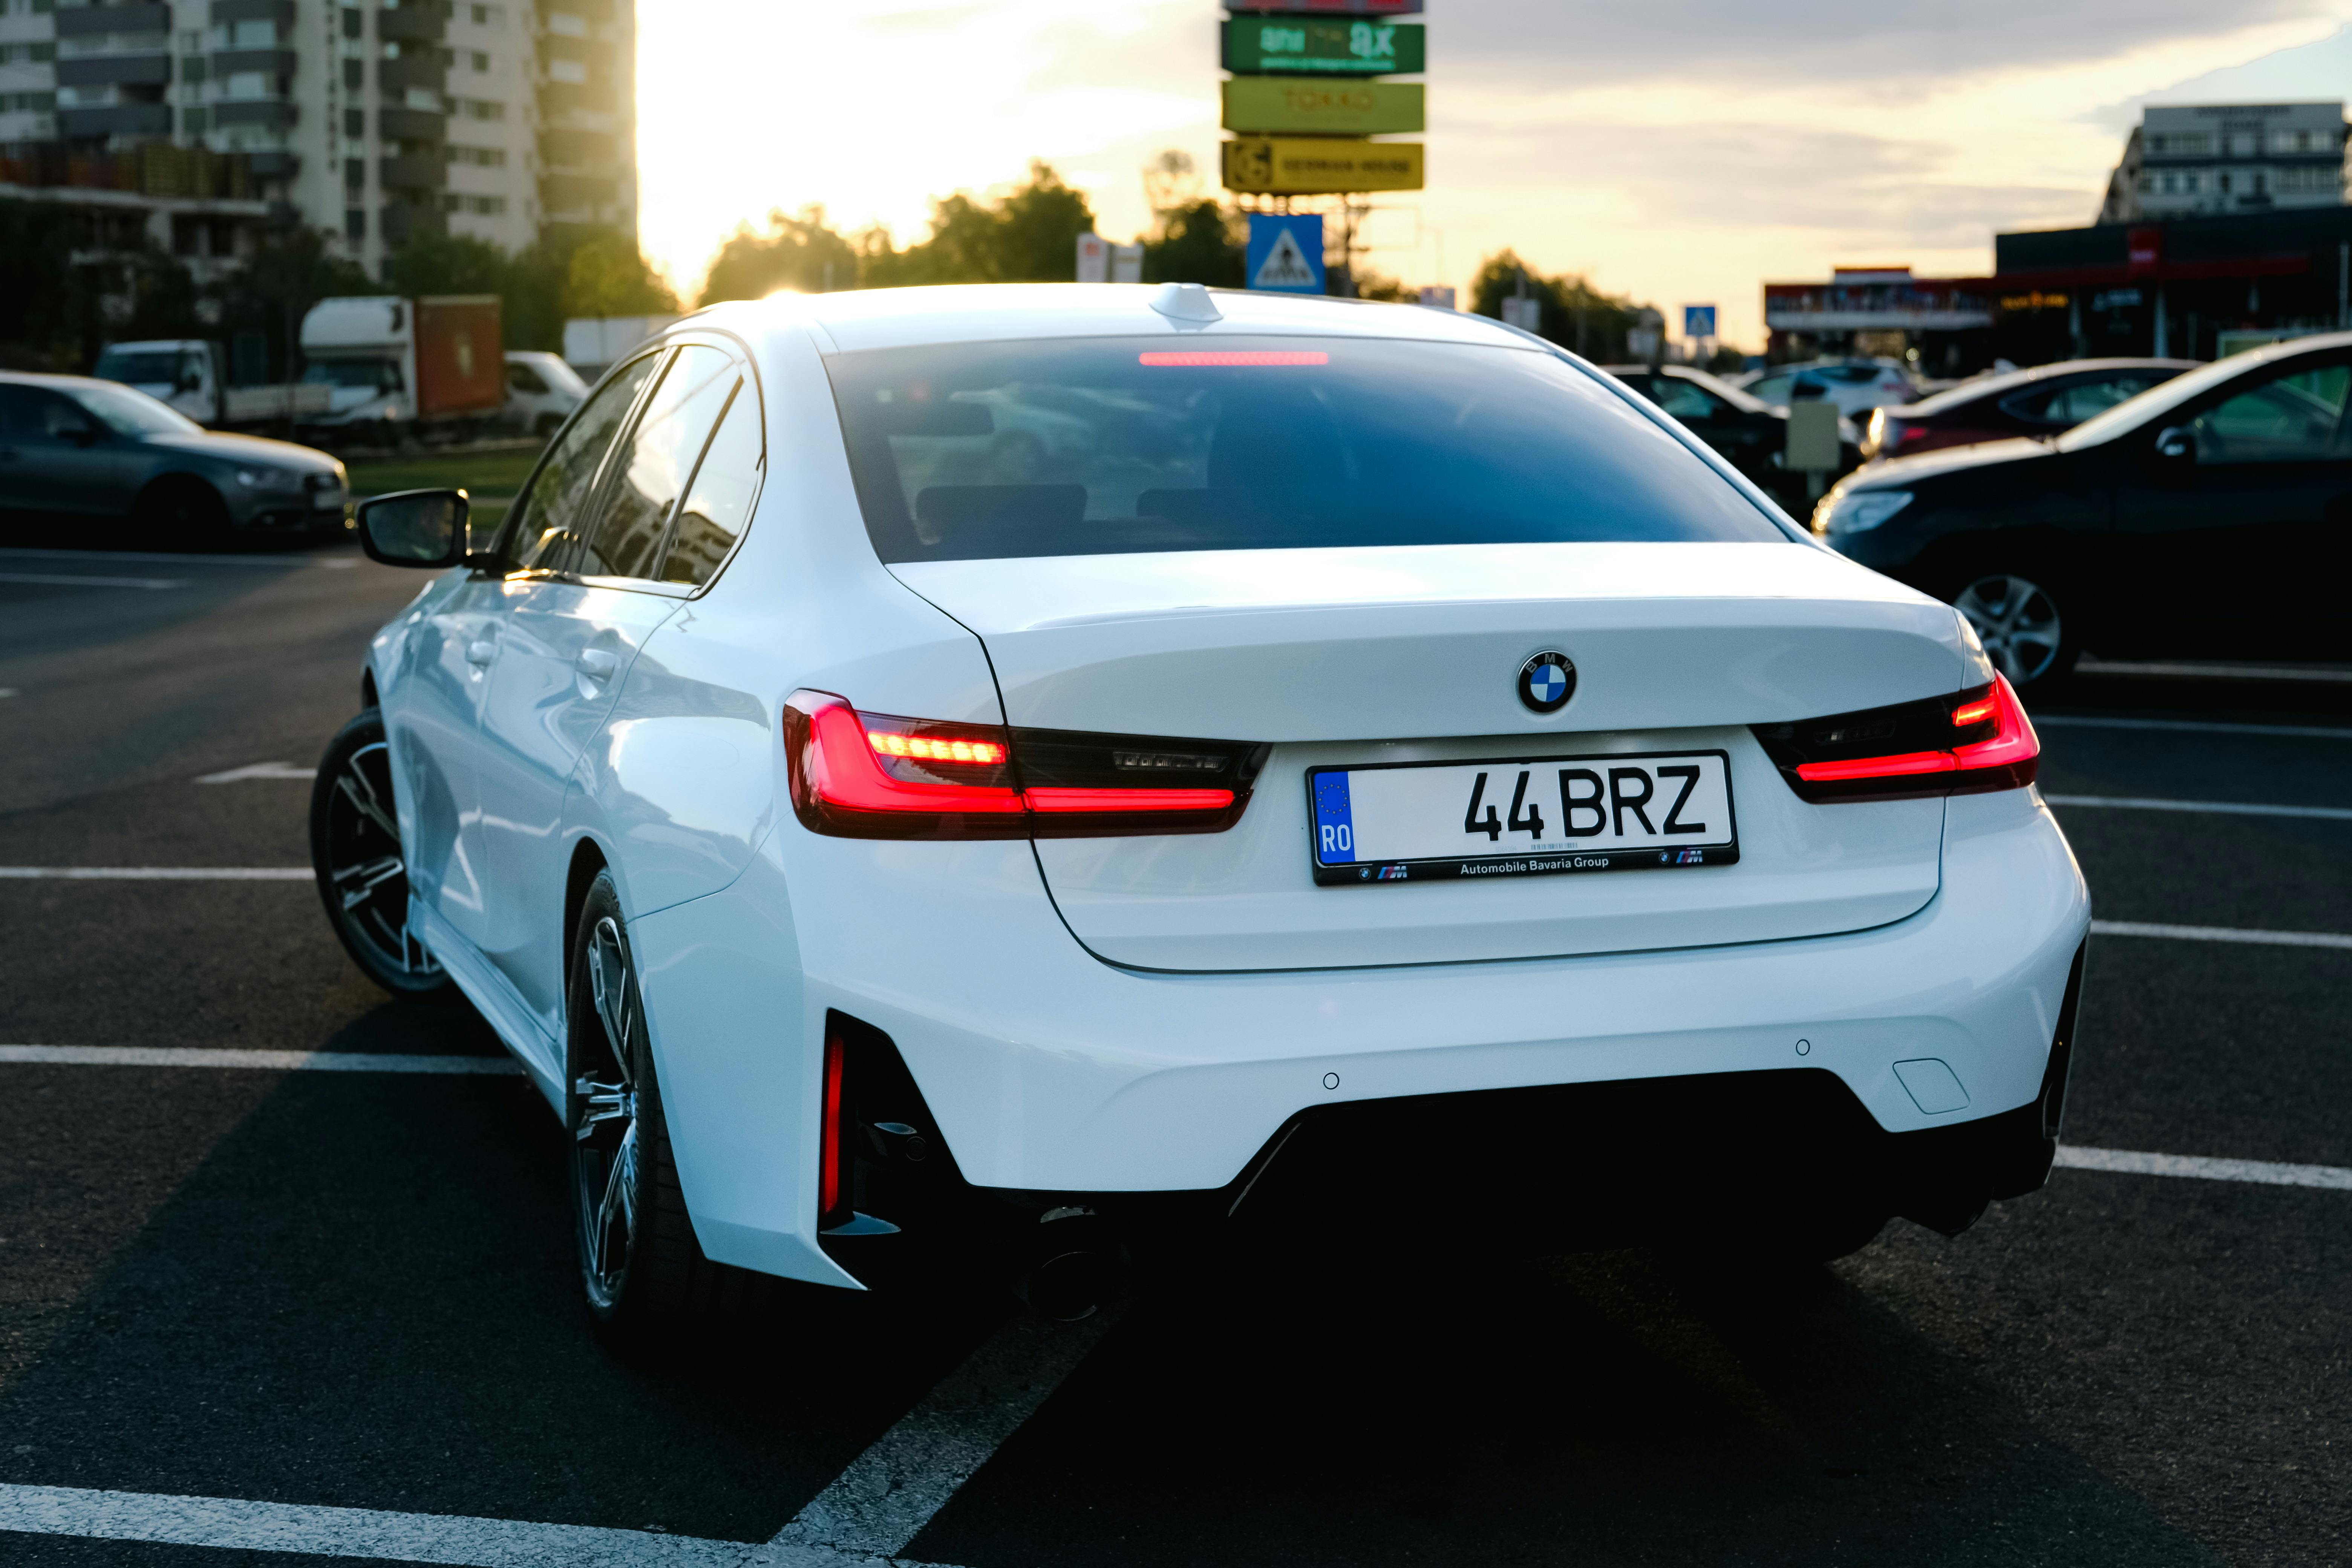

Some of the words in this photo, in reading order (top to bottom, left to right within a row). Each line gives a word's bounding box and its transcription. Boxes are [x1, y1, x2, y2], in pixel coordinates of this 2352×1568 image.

[1525, 653, 1573, 673] BMW
[1464, 770, 1545, 841] 44
[1558, 765, 1706, 838] BRZ
[1321, 824, 1351, 852] RO
[1461, 861, 1527, 874] Automobile
[1529, 858, 1571, 870] Bavaria
[1574, 857, 1609, 868] Group
